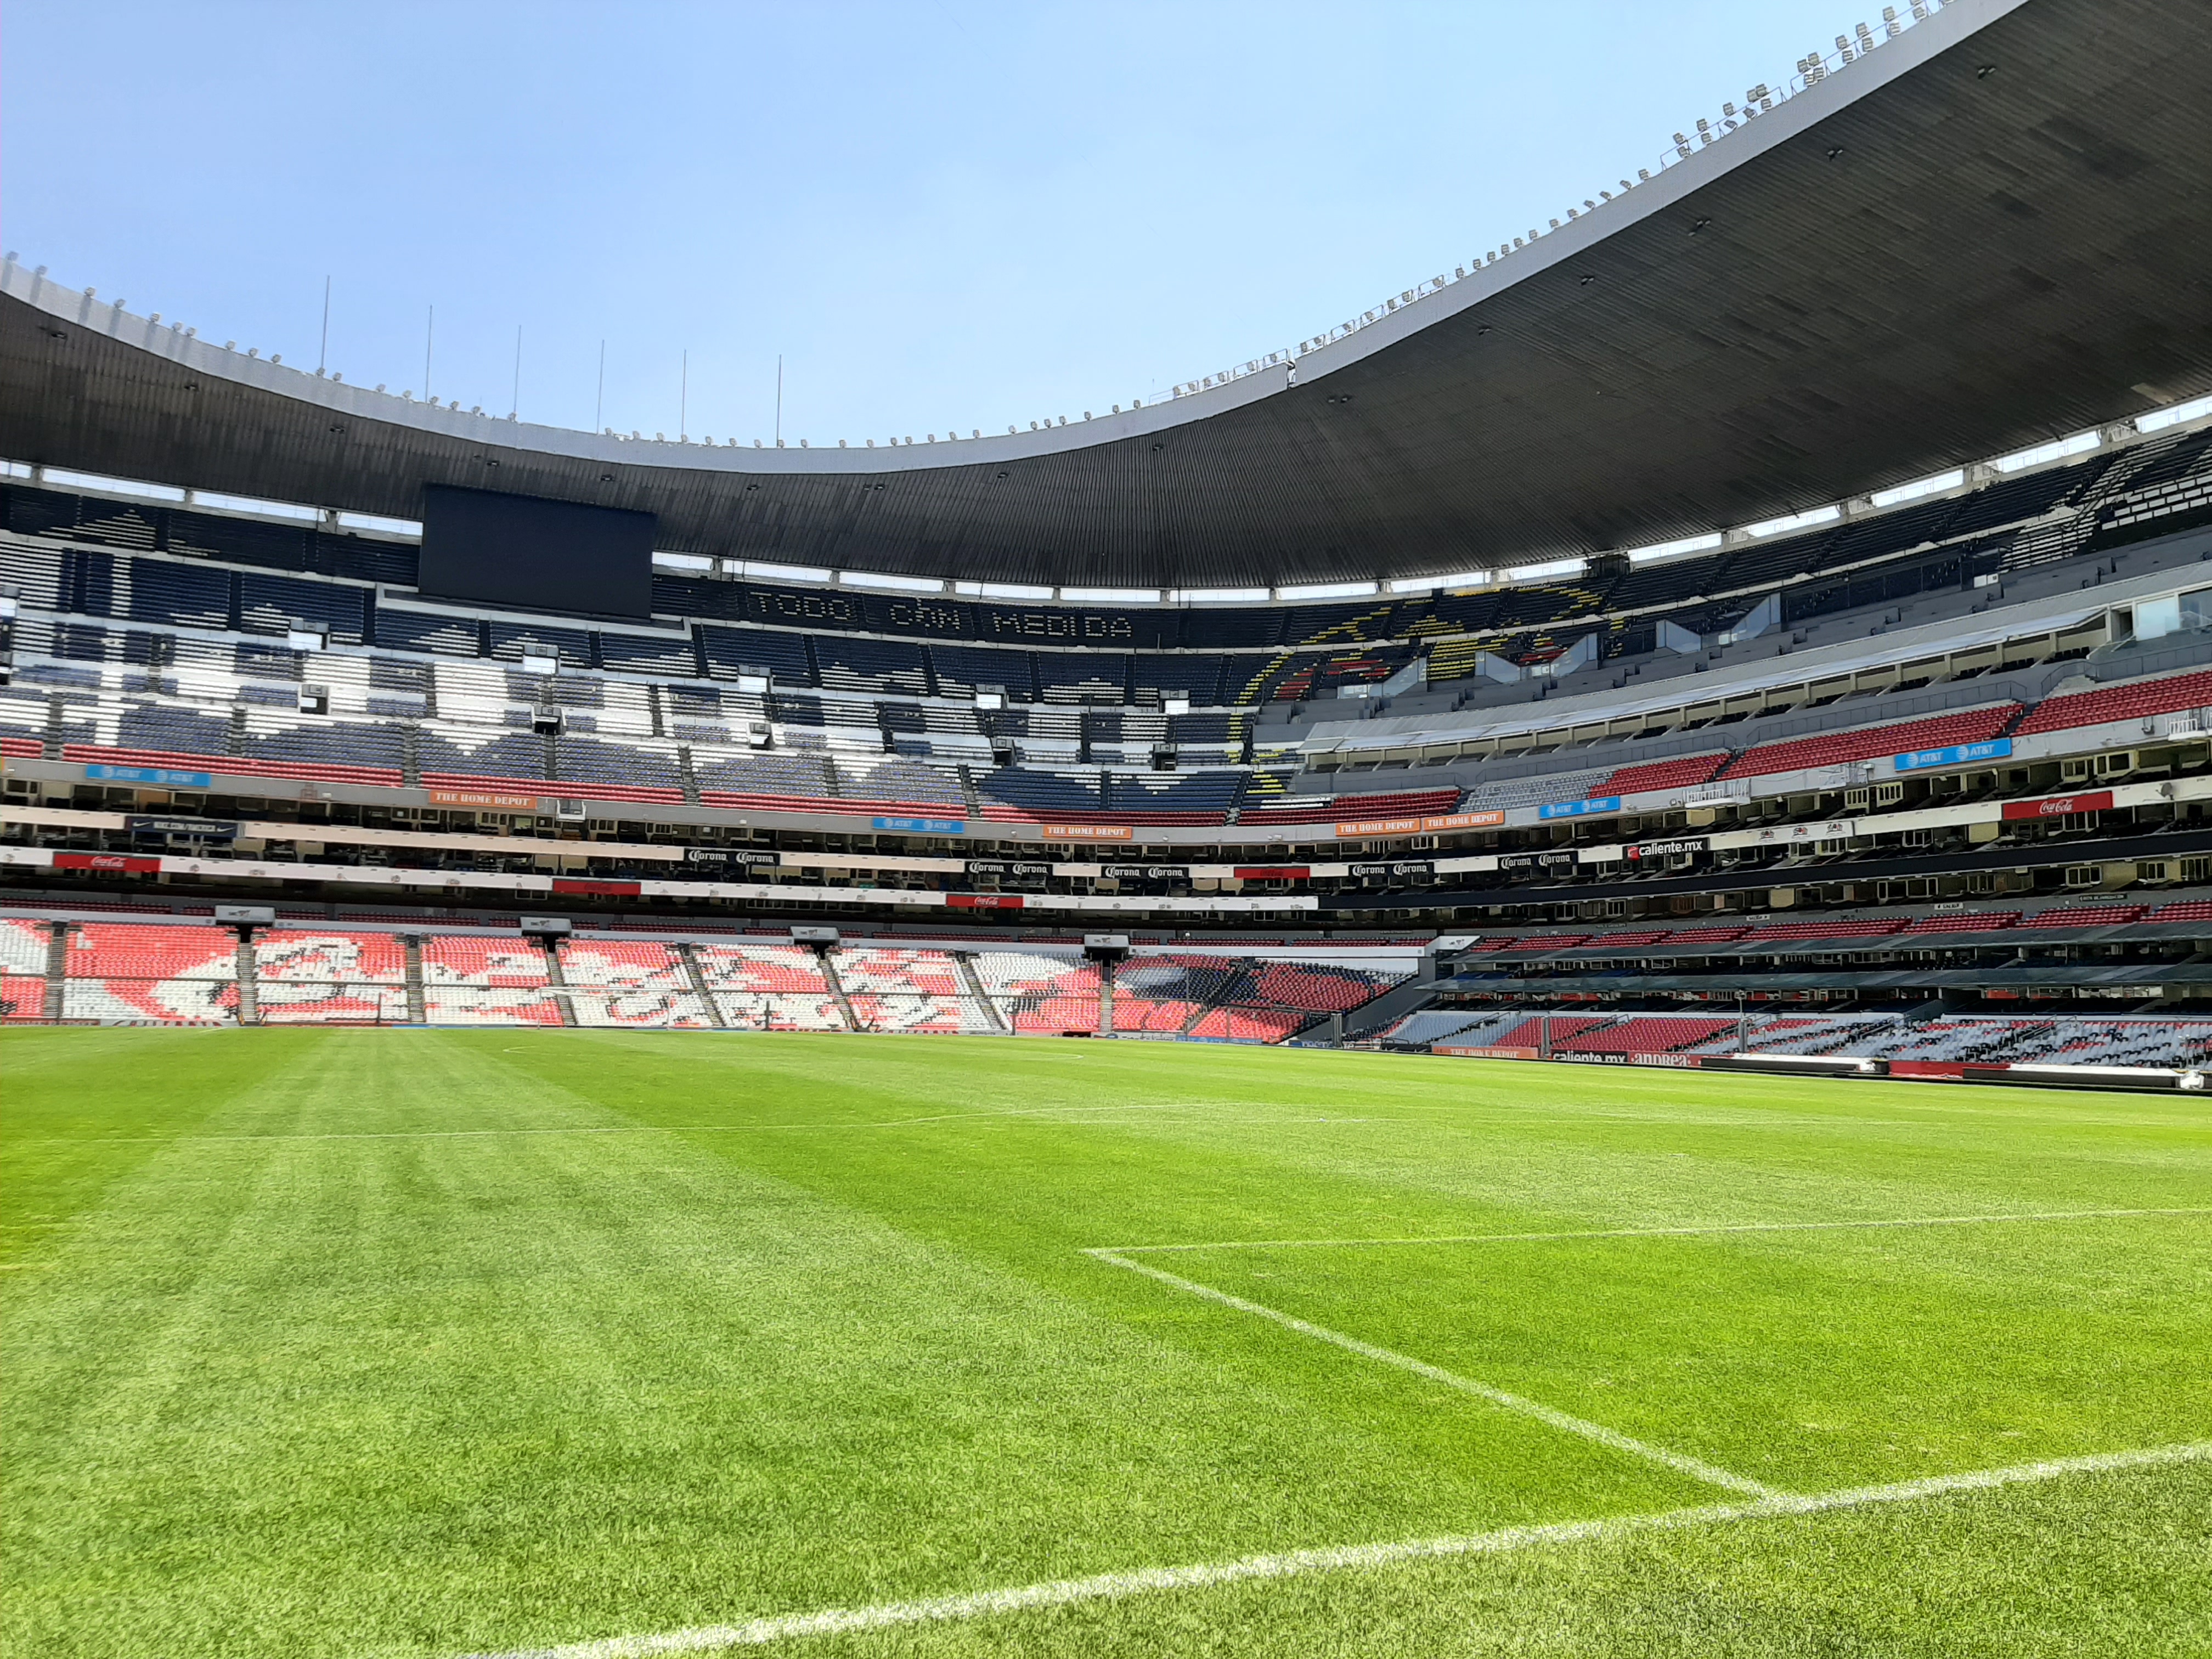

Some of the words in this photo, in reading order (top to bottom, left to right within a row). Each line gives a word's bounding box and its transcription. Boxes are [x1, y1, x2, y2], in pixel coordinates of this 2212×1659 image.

[750, 592, 851, 620] TODO
[890, 600, 960, 629] CON
[992, 612, 1132, 637] MEDIDA
[1920, 752, 1943, 763] AT&T
[1970, 744, 1994, 757] AT&T
[115, 769, 142, 778] AT&T
[169, 773, 195, 782] AT&T
[436, 792, 458, 802] THE
[460, 794, 492, 804] HOME
[494, 796, 531, 806] DEPOT
[1556, 805, 1573, 814] AT&T
[1591, 800, 1608, 809] AT&T
[2039, 799, 2075, 814] Coca-Cola
[1359, 823, 1383, 832] HOME
[1385, 821, 1415, 830] DEPOT
[1428, 819, 1444, 827] THE
[1446, 816, 1470, 825] HOME
[1471, 814, 1499, 823] DEPOT
[1096, 827, 1127, 836] DEPOT
[1639, 840, 1703, 856] caliente.mx
[689, 850, 728, 863] Corona
[736, 852, 776, 865] Corona
[1501, 857, 1532, 870] Corona
[1538, 854, 1572, 867] Corona
[969, 862, 1006, 873] Corona
[1012, 863, 1048, 875] Corona
[1105, 866, 1141, 878] Corona
[1148, 866, 1184, 878] Corona
[1352, 865, 1386, 877] Corona
[1393, 864, 1427, 876] Corona
